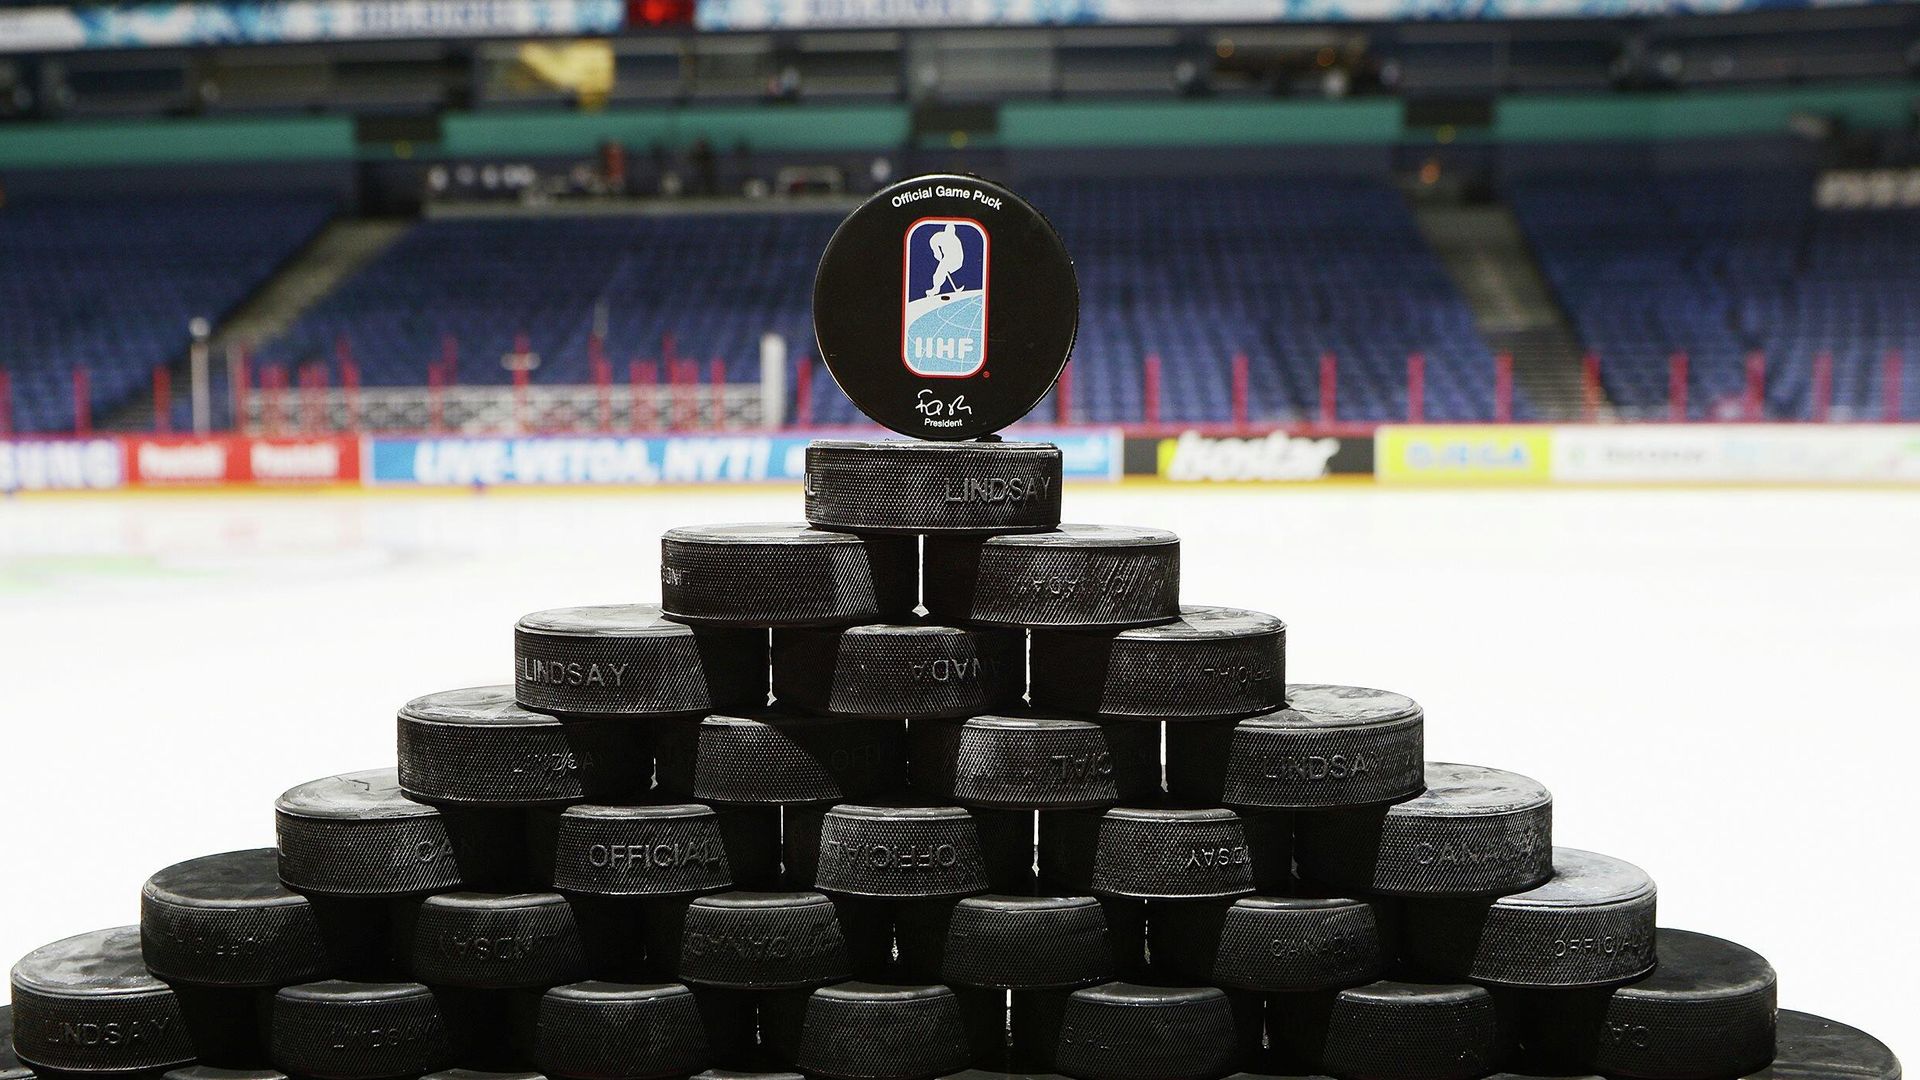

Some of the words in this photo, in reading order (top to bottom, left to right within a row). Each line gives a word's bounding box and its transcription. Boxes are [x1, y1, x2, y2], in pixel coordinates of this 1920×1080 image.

[891, 186, 933, 208] Official
[935, 186, 971, 199] Game
[972, 190, 1003, 211] Puck
[915, 336, 974, 359] IIHF
[924, 418, 963, 428] President
[944, 476, 1051, 502] LINDSAY
[523, 656, 628, 688] LINDSAY
[588, 841, 720, 868] OFFICIAL
[828, 839, 958, 868] OFFICIAL
